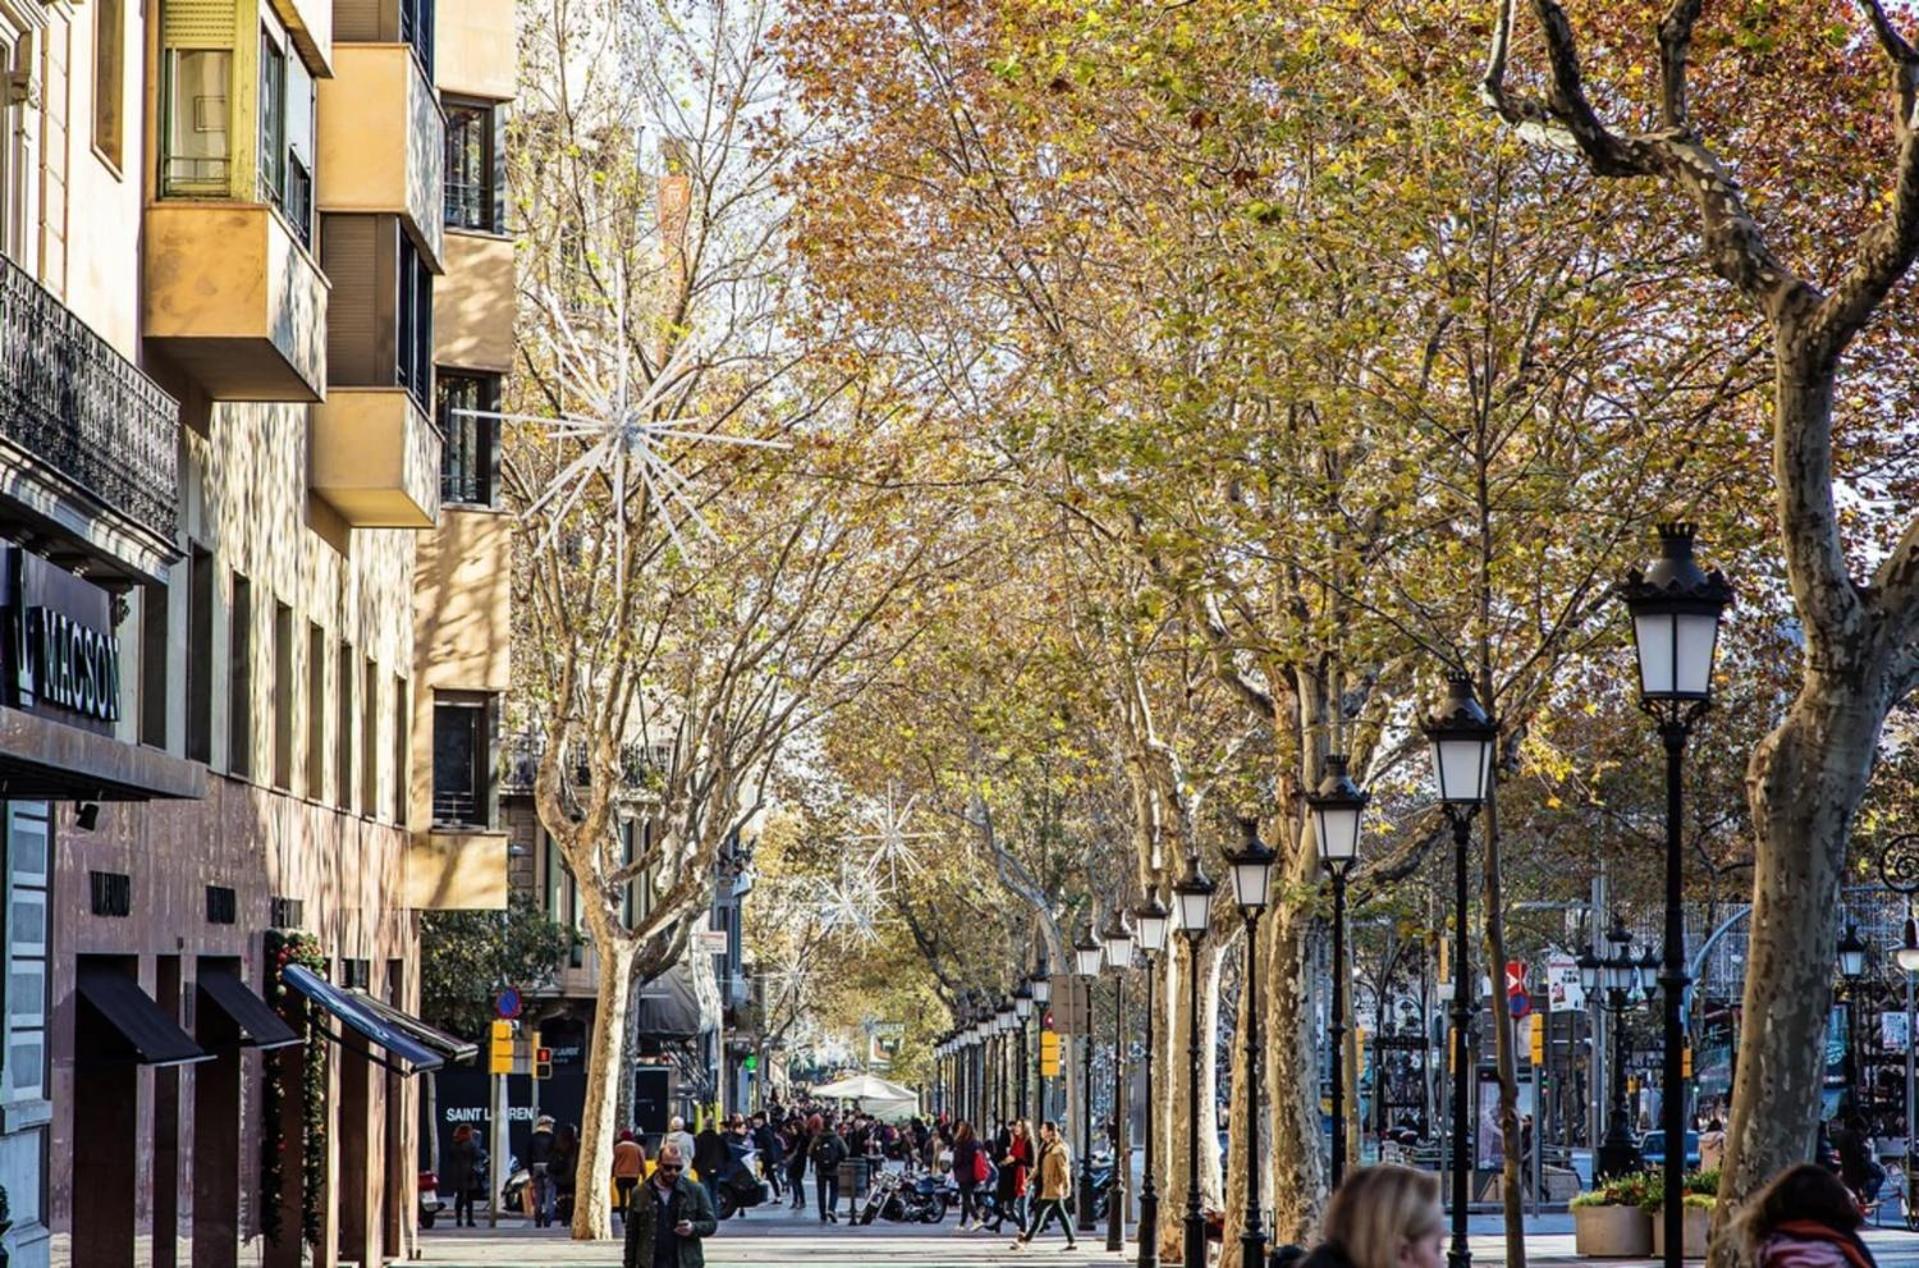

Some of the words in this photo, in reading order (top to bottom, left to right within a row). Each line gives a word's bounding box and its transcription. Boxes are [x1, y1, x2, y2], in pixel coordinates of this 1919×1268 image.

[42, 606, 120, 721] MACSON
[446, 1107, 482, 1121] SAINT
[484, 1106, 541, 1121] LREN
